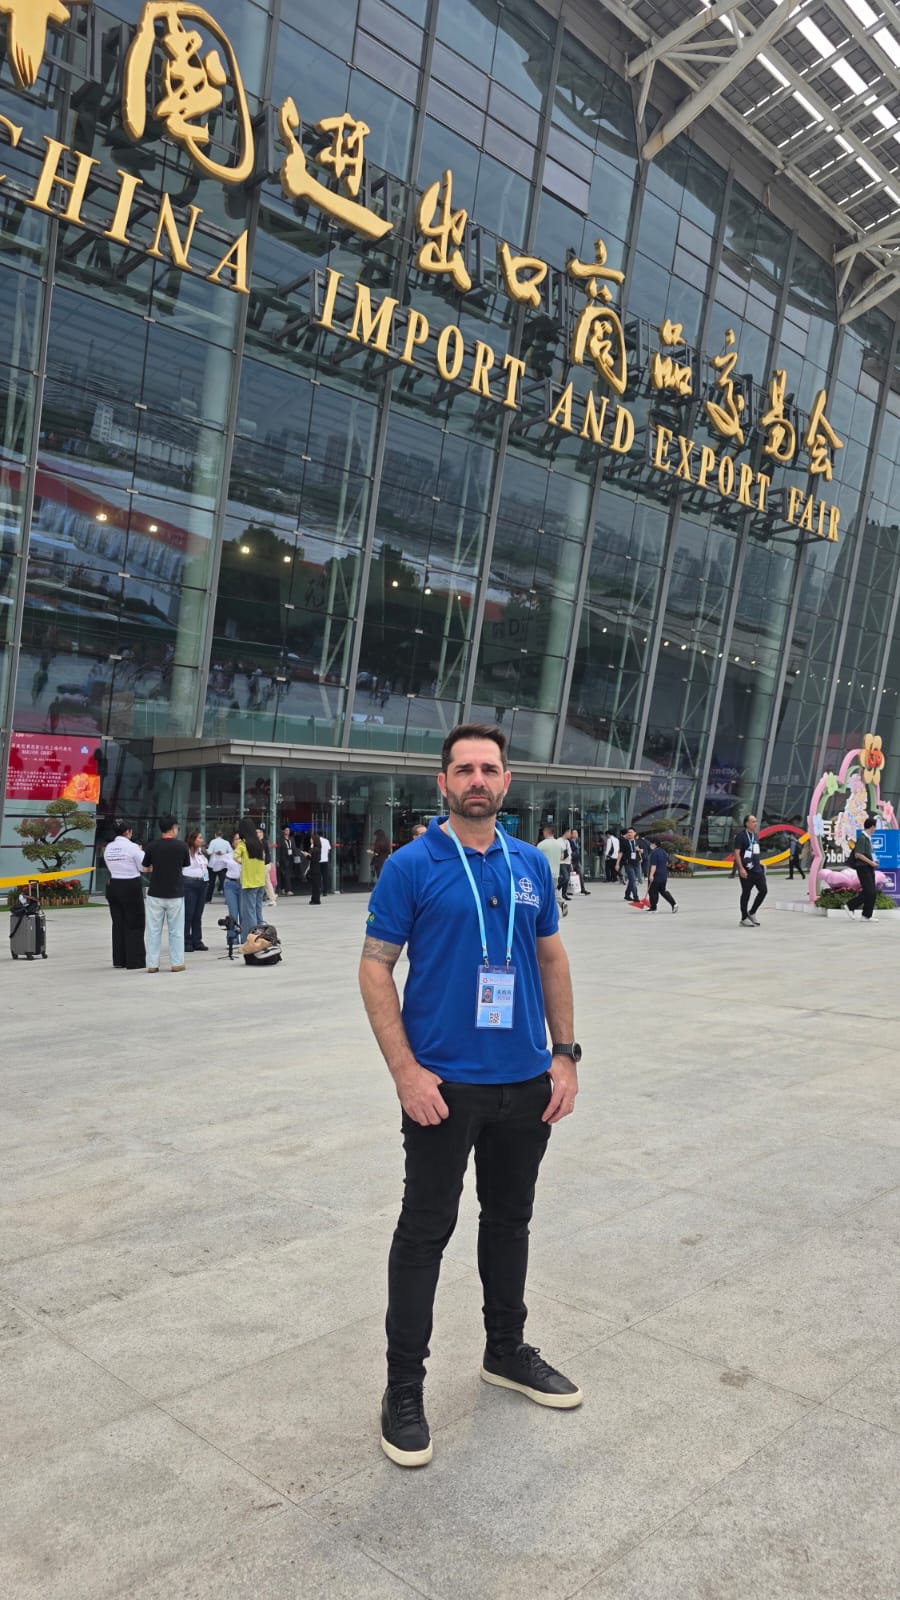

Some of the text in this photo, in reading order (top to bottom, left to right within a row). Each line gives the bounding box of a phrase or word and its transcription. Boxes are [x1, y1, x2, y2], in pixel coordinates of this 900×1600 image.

[316, 267, 526, 410] IMPORT
[547, 381, 636, 454] AND
[652, 425, 771, 513] EXPORT
[786, 487, 841, 542] FAIR
